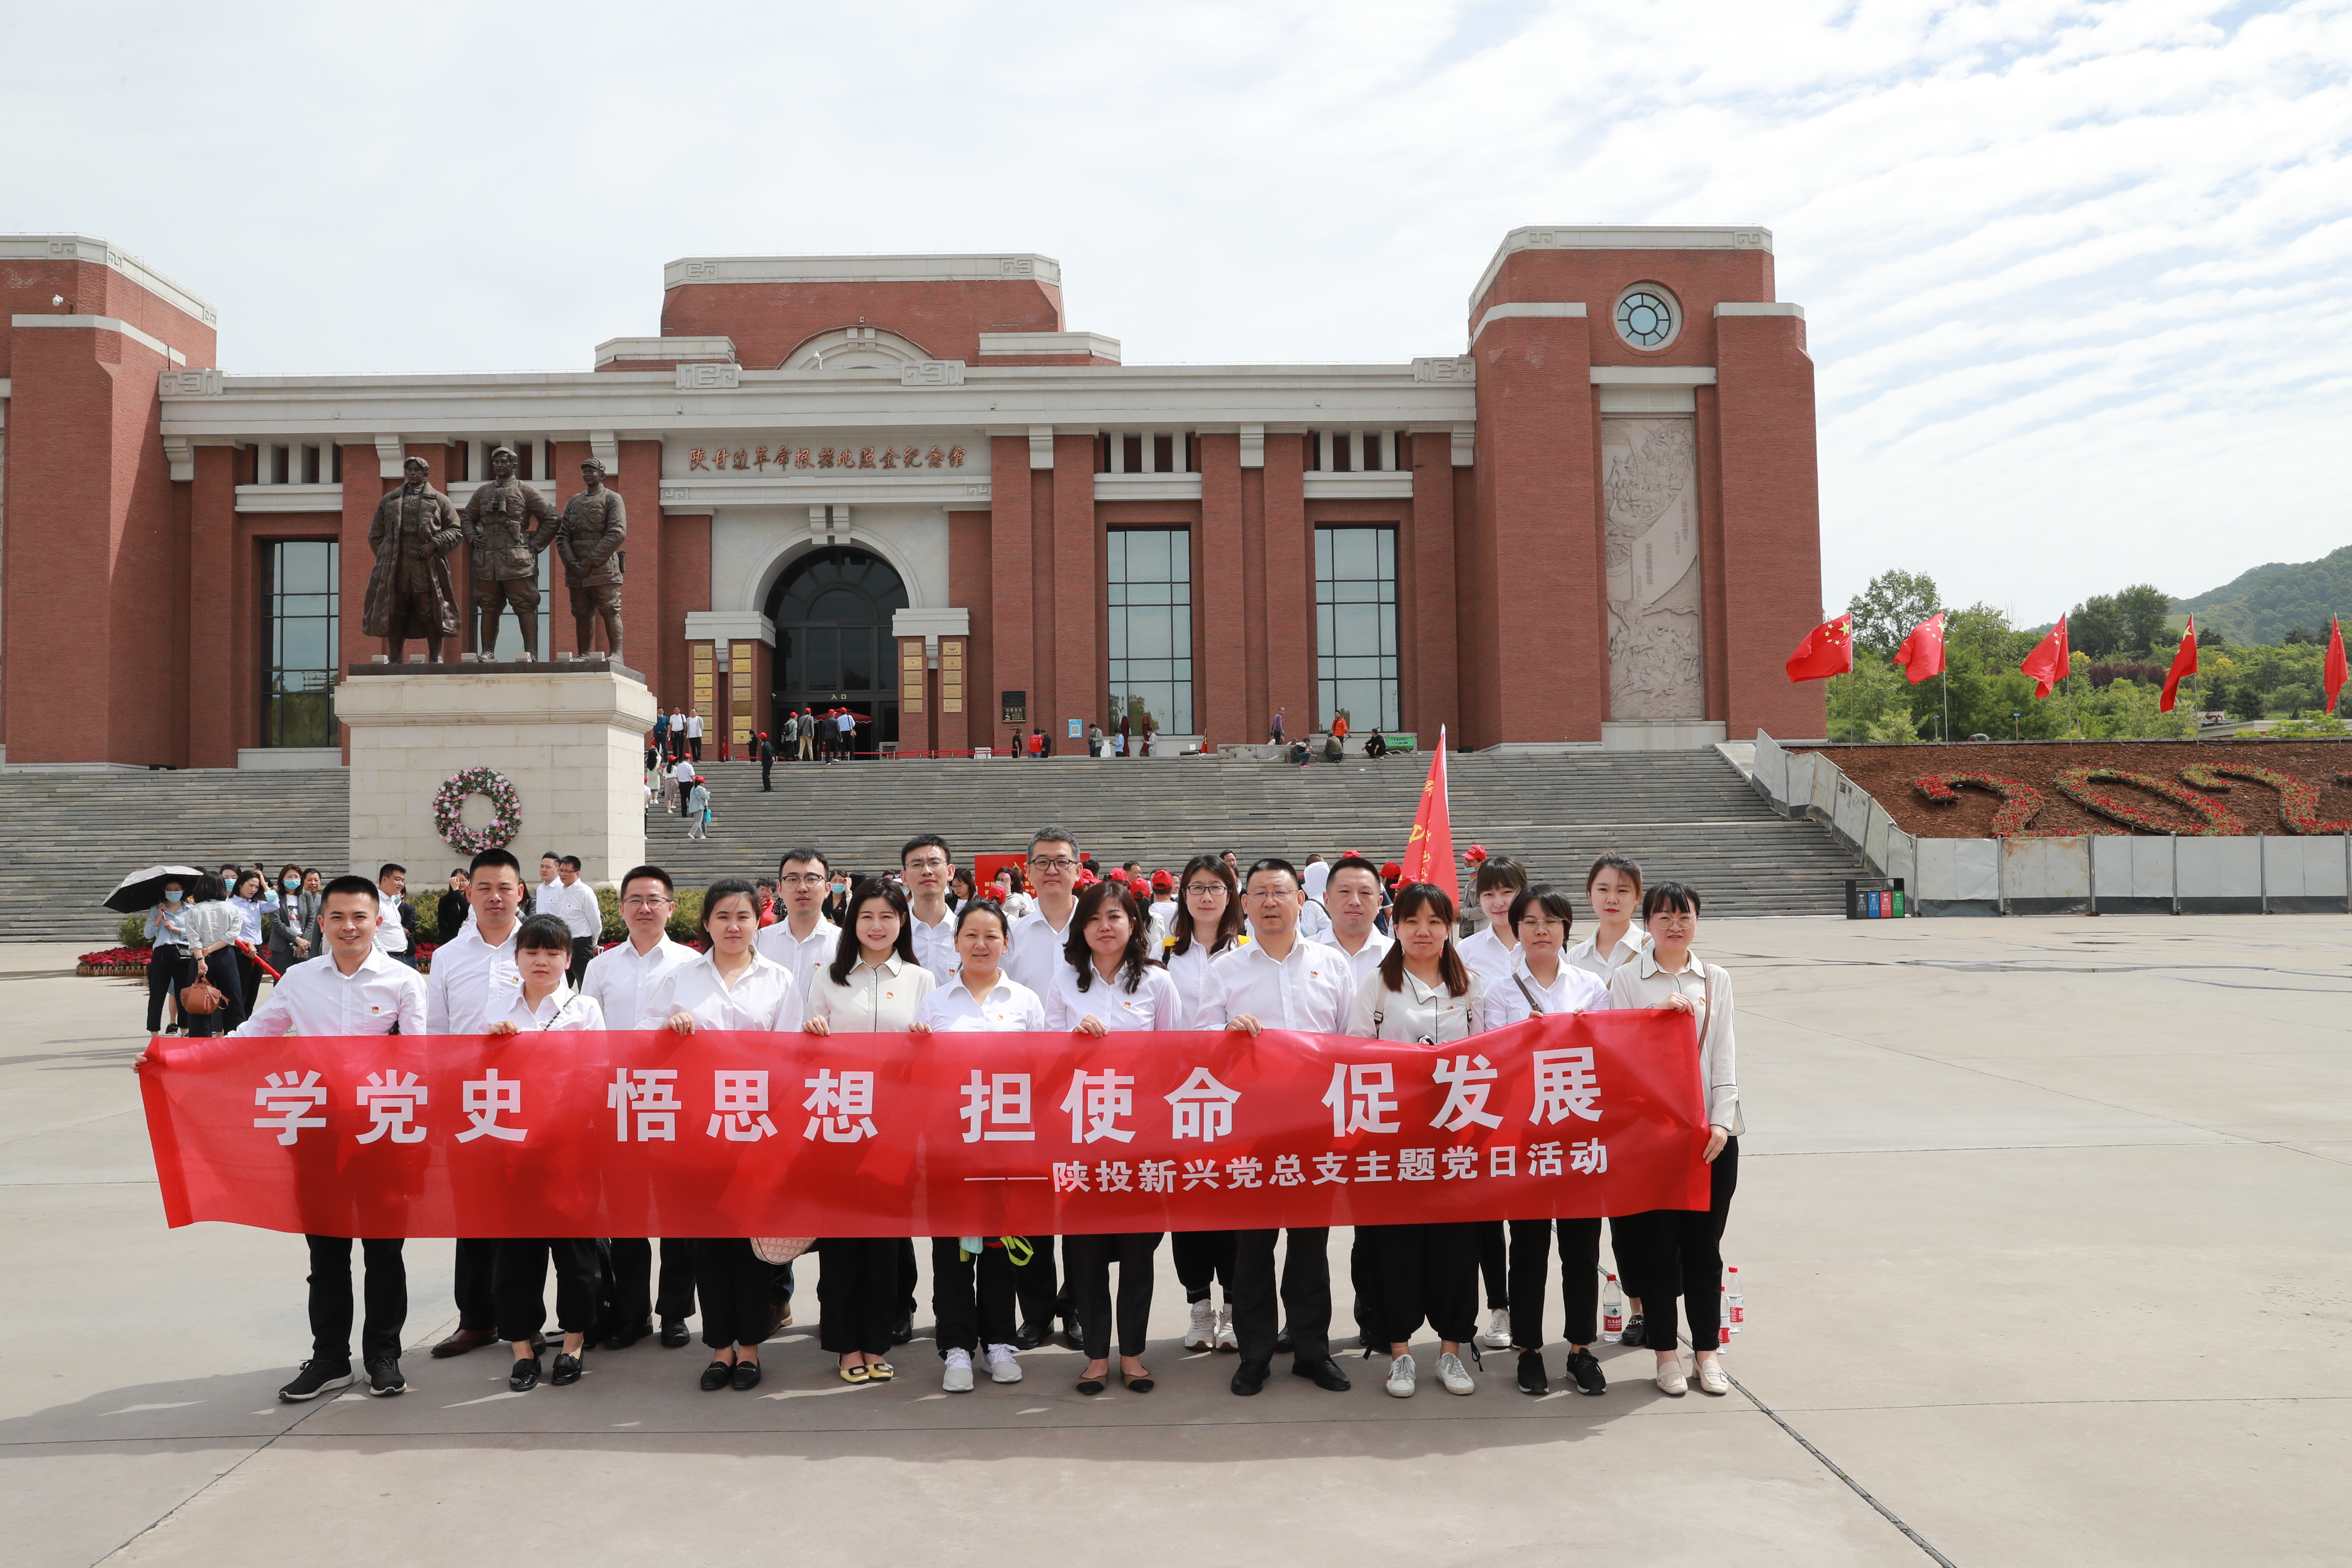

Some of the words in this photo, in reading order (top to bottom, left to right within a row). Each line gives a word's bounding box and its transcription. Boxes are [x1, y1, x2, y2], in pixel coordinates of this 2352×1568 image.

[254, 1068, 528, 1146] 学党史
[607, 1068, 879, 1143] 悟思想
[959, 1066, 1242, 1144] 担使命
[1321, 1047, 1603, 1137] 促发展
